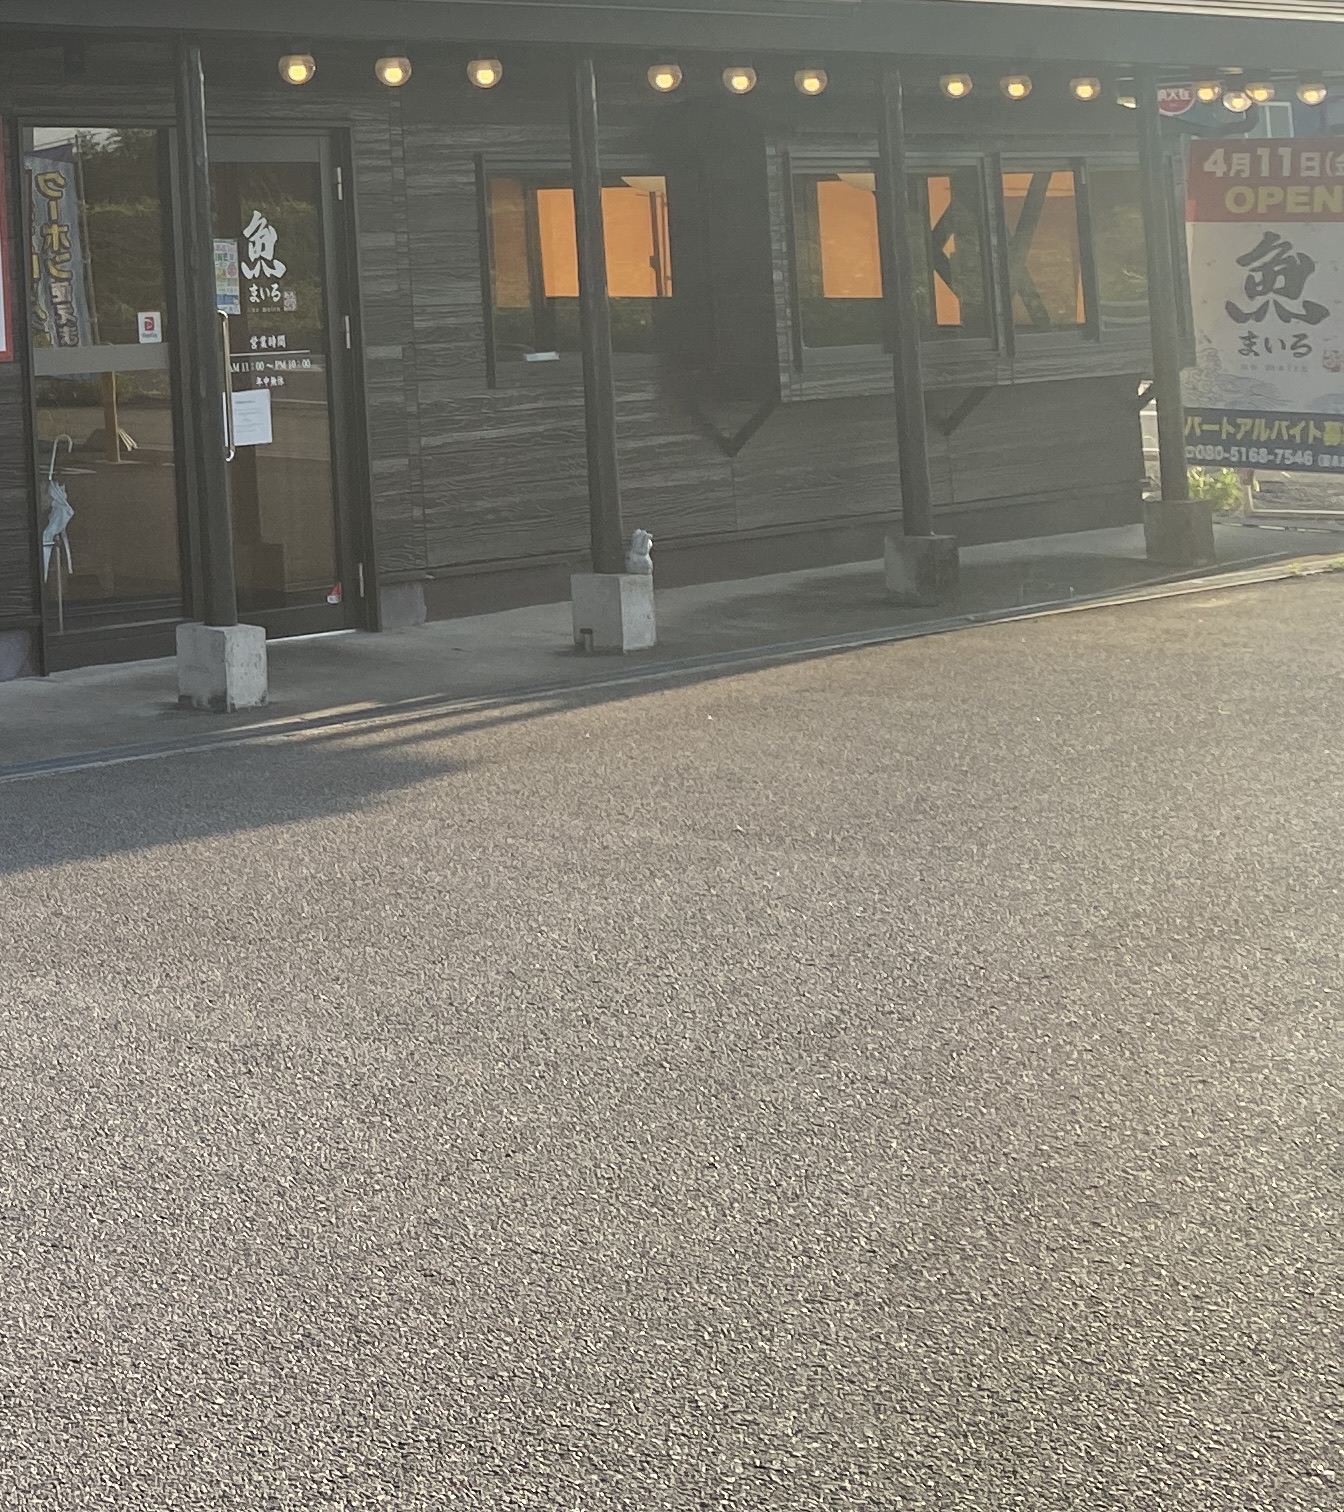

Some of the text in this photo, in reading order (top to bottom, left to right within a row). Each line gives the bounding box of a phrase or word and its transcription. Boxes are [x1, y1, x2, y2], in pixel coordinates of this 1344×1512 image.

[1225, 185, 1344, 214] OPEN
[241, 210, 287, 280] 魚
[1225, 231, 1330, 325] 魚
[249, 283, 281, 303] まいる
[250, 335, 286, 349] 営業時間
[1238, 330, 1313, 358] まいる
